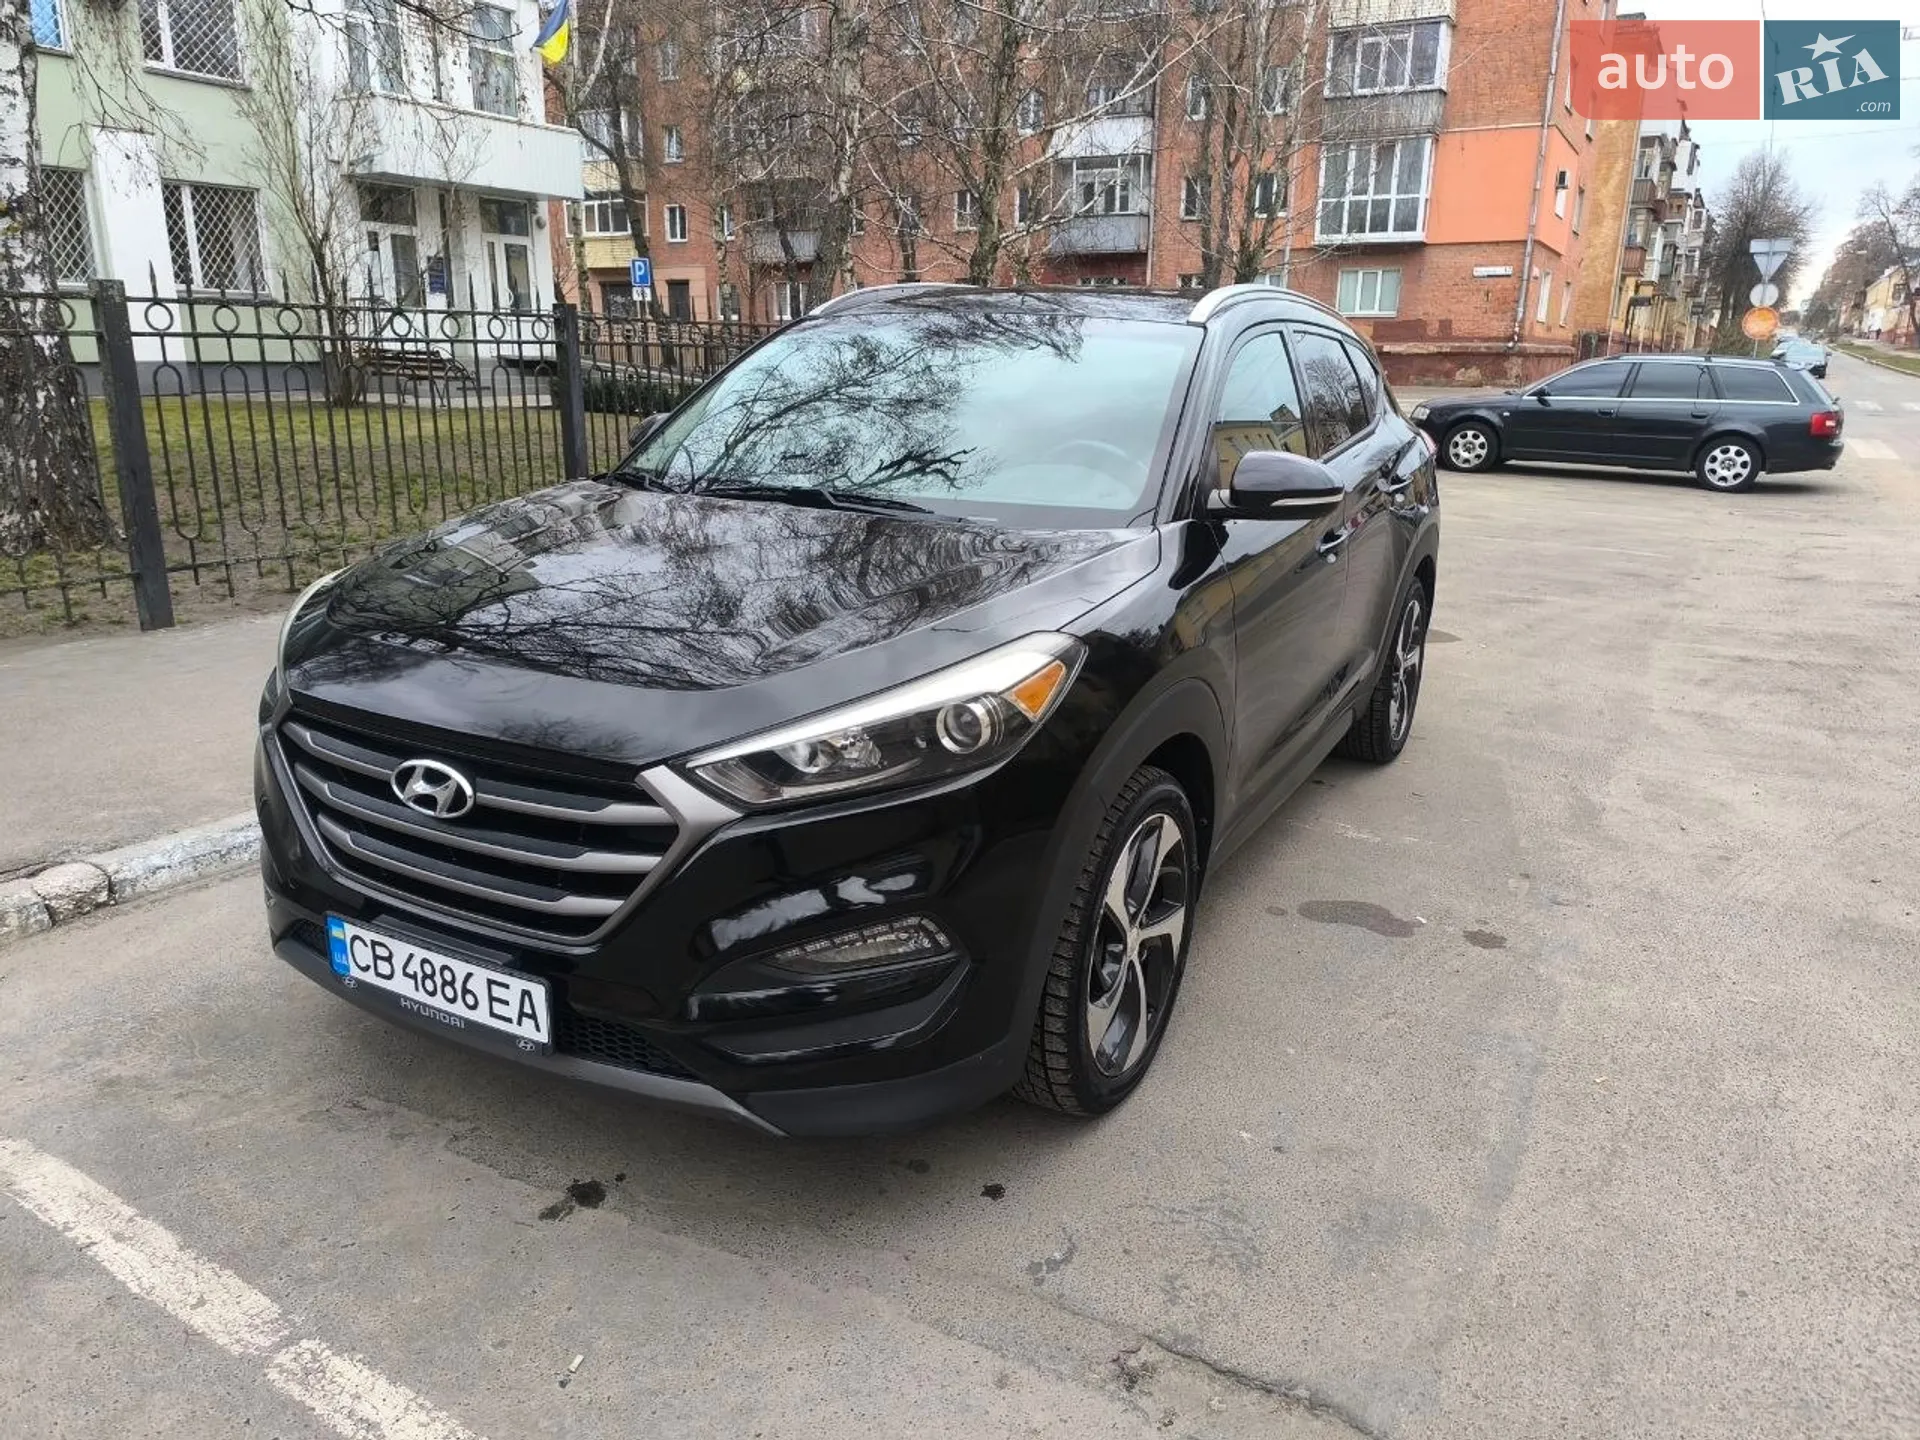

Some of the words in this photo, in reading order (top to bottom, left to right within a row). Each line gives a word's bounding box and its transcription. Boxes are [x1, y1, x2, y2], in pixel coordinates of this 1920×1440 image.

[634, 261, 645, 283] P
[350, 934, 395, 980] CB
[402, 953, 479, 1011] 4886
[486, 978, 541, 1033] EA
[400, 998, 465, 1029] HYUNDAI
